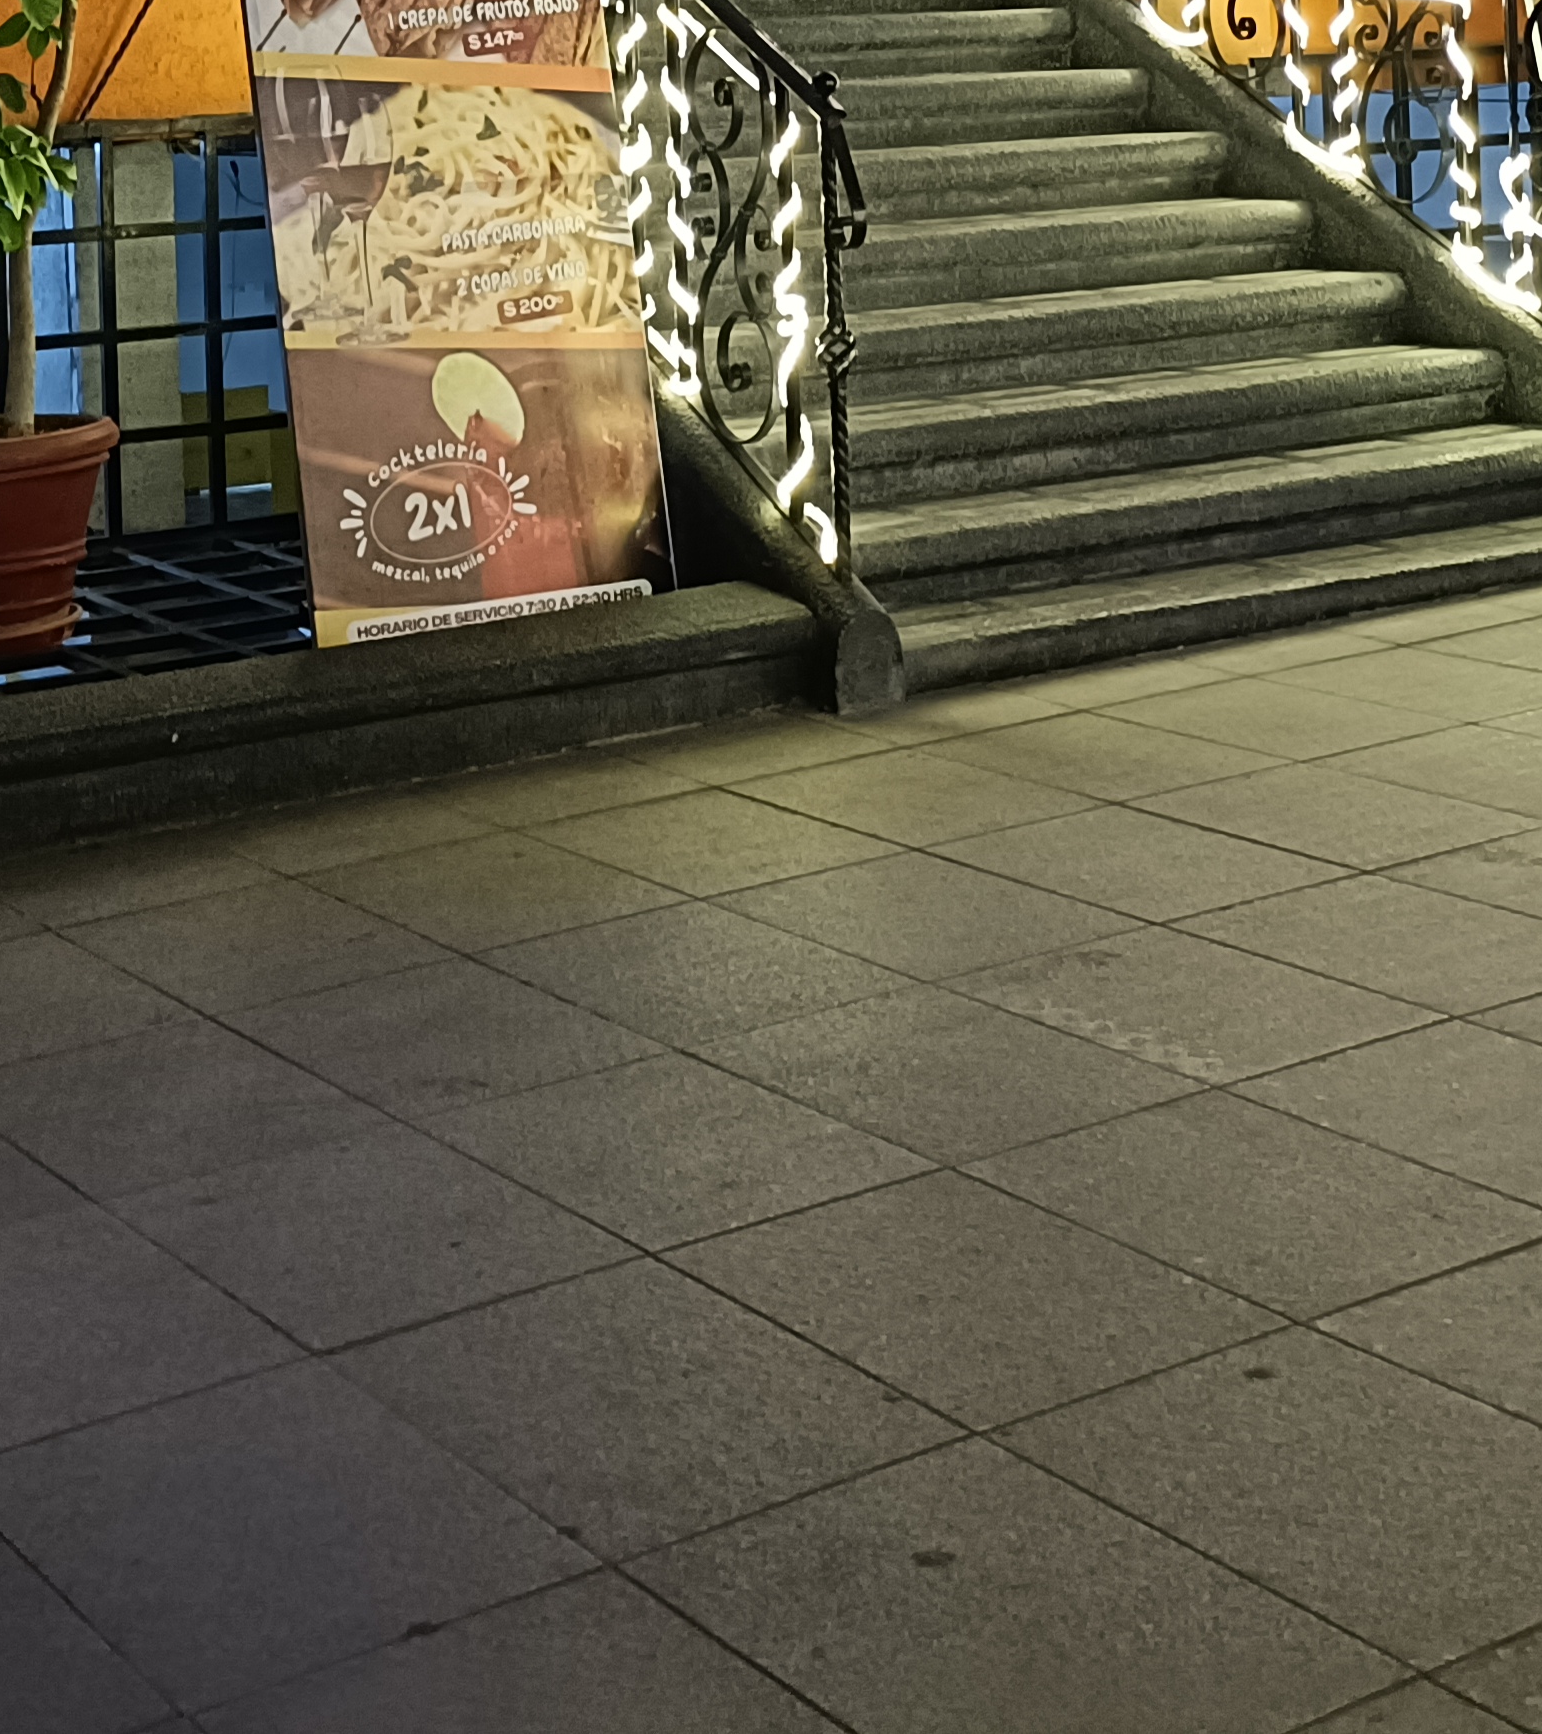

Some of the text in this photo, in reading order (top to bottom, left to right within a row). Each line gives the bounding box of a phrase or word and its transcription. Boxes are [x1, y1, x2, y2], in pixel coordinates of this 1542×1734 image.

[398, 7, 449, 30] CREPA
[453, 4, 474, 23] DE
[442, 214, 586, 252] PASTA CARBONARA
[456, 260, 586, 298] 2 COPAS DE VINO
[404, 483, 472, 542] 2x1
[435, 552, 486, 580] tequila
[357, 616, 429, 640] HORARIO
[431, 613, 453, 628] DE
[454, 604, 524, 625] SERVICIO
[559, 598, 569, 610] A
[613, 586, 644, 601] HRS
